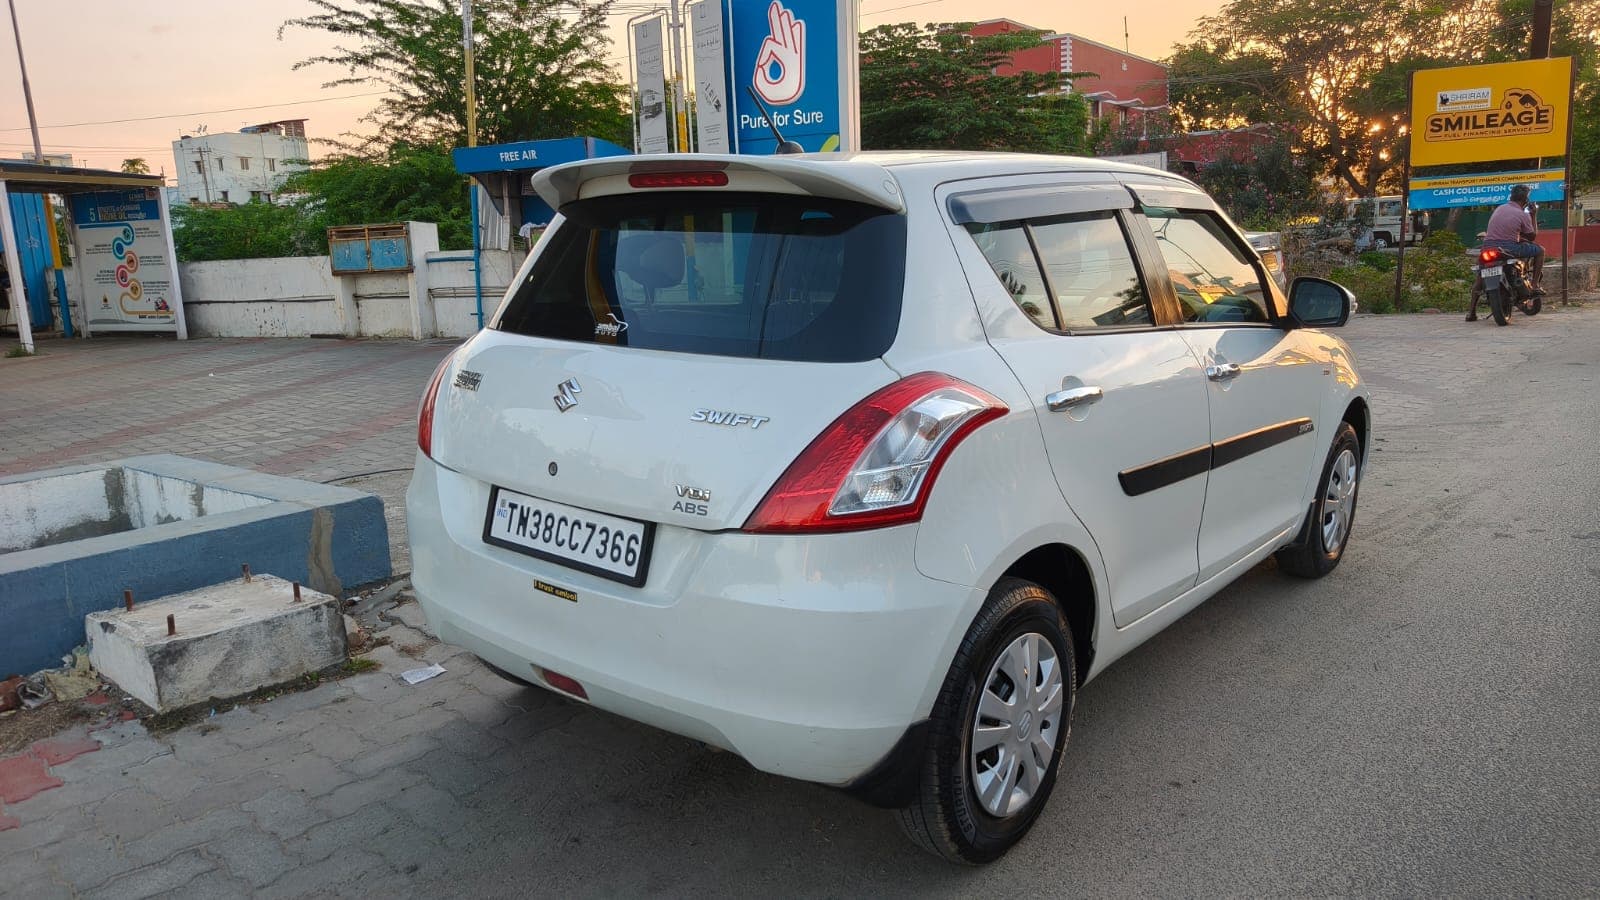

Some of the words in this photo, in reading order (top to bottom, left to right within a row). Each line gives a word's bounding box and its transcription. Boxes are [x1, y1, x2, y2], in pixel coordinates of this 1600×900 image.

[1450, 90, 1490, 101] SHRIRAM
[741, 114, 769, 129] Pure
[774, 111, 790, 127] for
[793, 109, 823, 125] Sure
[1430, 108, 1549, 133] SMILEAGE
[499, 151, 520, 162] FREE
[522, 149, 538, 160] AIR
[1432, 188, 1454, 196] CASH
[1455, 184, 1506, 195] COLLECTION
[89, 207, 96, 222] 5
[690, 407, 770, 429] SWIFT
[672, 500, 709, 516] ABS
[507, 502, 640, 567] TN38CC7366
